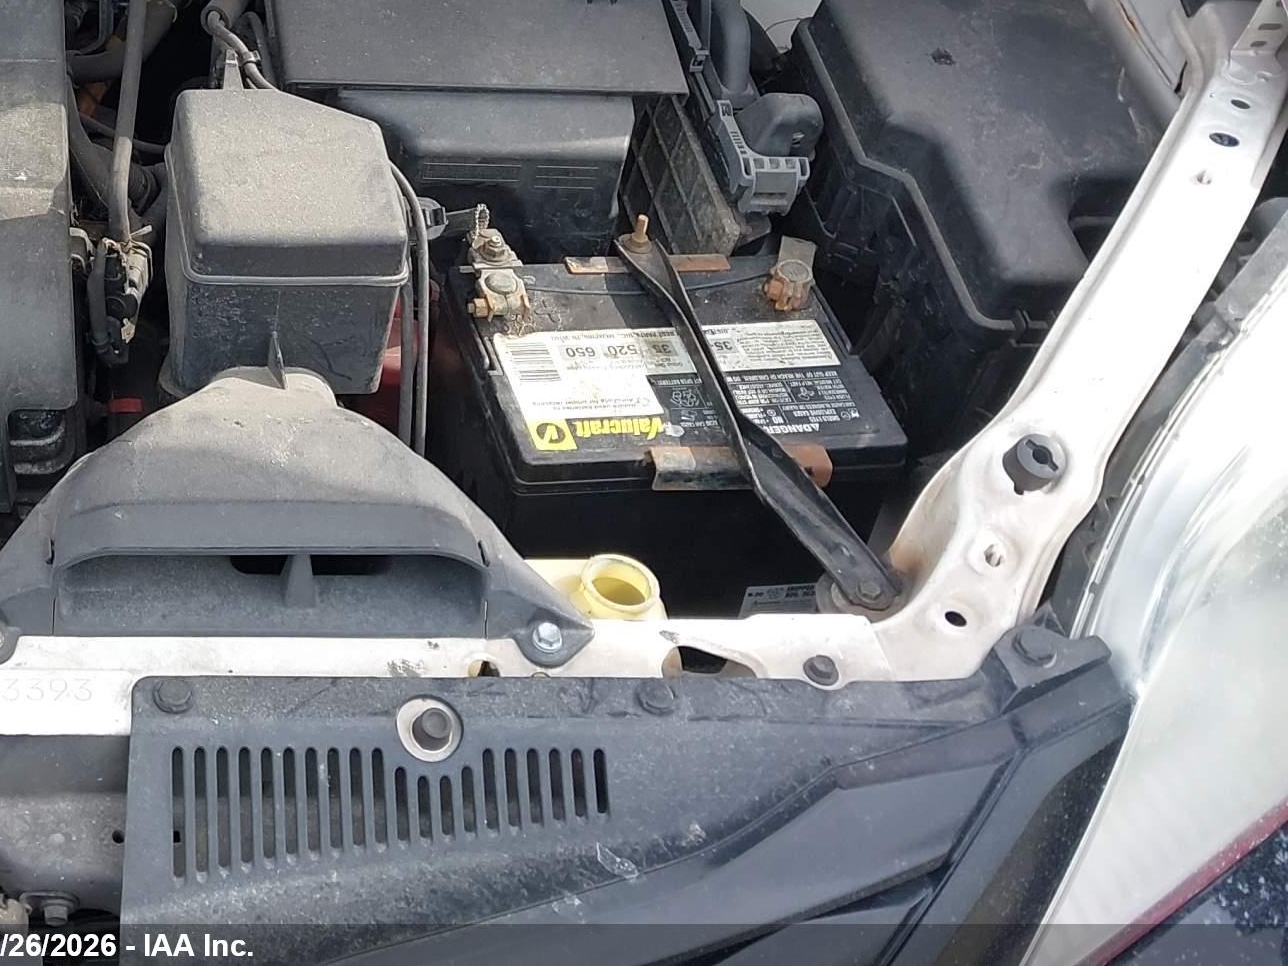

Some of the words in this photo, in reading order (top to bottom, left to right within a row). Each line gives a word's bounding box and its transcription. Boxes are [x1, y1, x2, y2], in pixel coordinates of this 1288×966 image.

[565, 347, 596, 358] 650
[607, 345, 638, 355] 520
[652, 344, 670, 354] 35
[772, 416, 784, 424] NO
[572, 417, 665, 440] Valucraft
